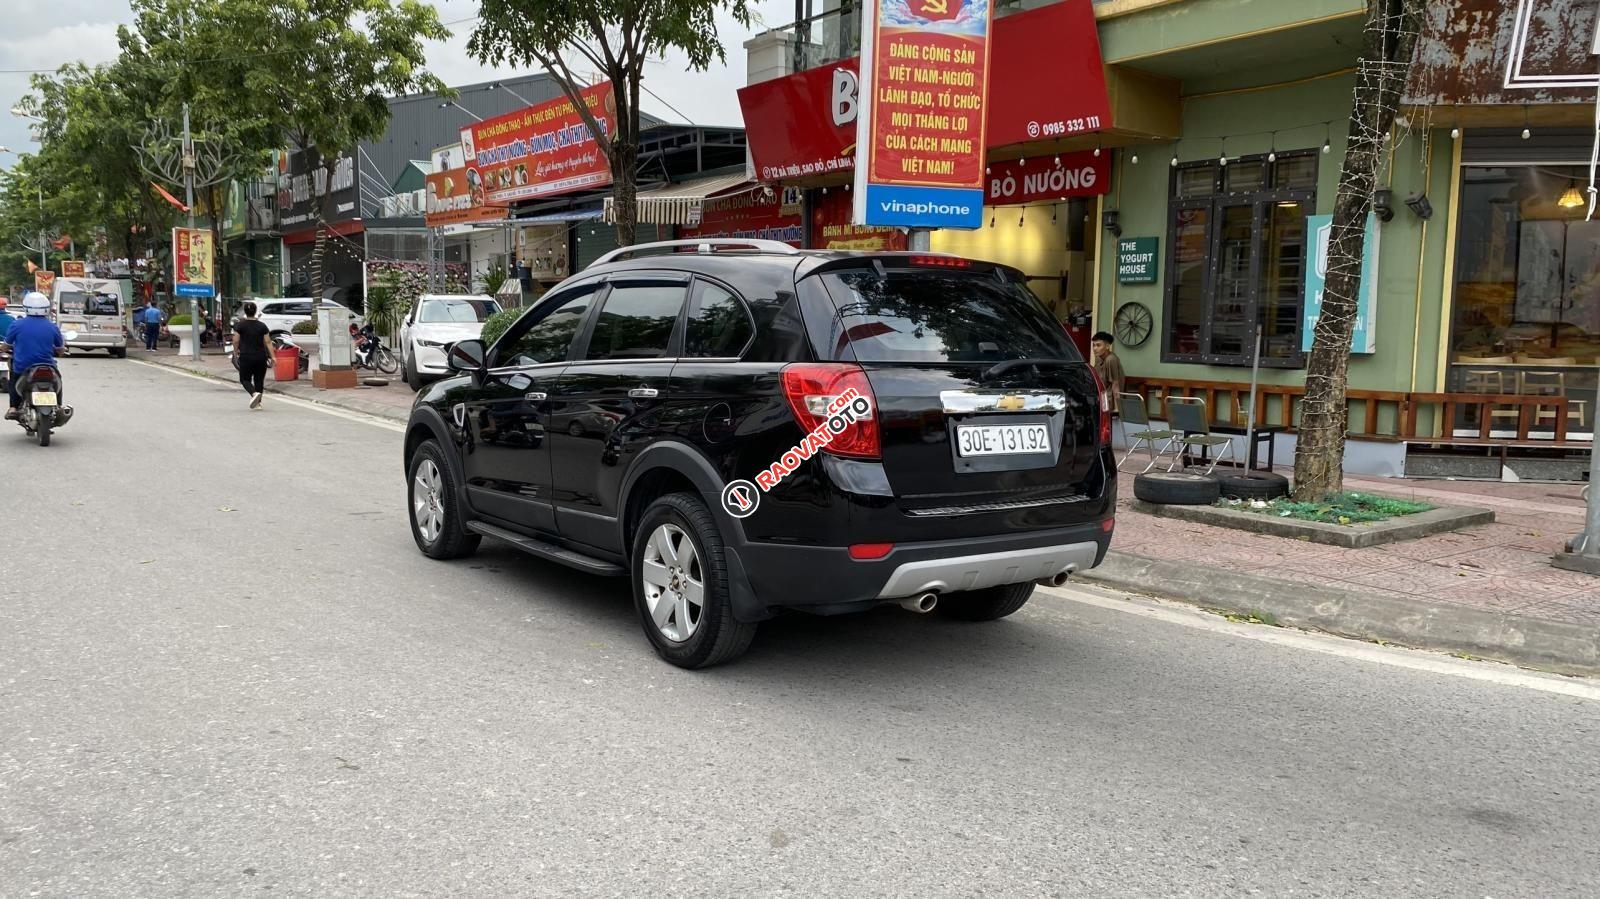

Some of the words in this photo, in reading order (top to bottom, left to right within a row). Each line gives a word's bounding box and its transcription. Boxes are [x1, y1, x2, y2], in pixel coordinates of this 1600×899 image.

[890, 38, 919, 59] ĐẢNG
[922, 44, 951, 64] CỘNG
[954, 43, 975, 64] SẢN
[889, 64, 912, 84] VIỆT
[914, 68, 974, 87] NAM-NGƯỜI
[880, 86, 907, 104] LÃNH
[911, 91, 935, 108] ĐẠO,
[938, 88, 951, 108] TỔ
[953, 91, 980, 110] CHỨC
[891, 112, 912, 130] MỌI
[915, 110, 949, 130] THẮNG
[952, 116, 968, 134] LỢI
[1042, 121, 1065, 136] 0985
[1067, 118, 1085, 132] 332
[1086, 116, 1100, 129] 111
[886, 129, 907, 149] CỦA
[910, 134, 938, 151] CÁCH
[940, 138, 972, 156] MẠNG
[771, 167, 779, 178] 12
[802, 163, 814, 174] SAO
[902, 156, 924, 176] VIỆT
[926, 160, 955, 175] NAM!
[991, 169, 1016, 198] BÒ
[881, 200, 970, 215] vinaphone
[1121, 242, 1136, 251] THE
[1120, 253, 1153, 263] YOGURT
[1120, 265, 1146, 274] HOUSE
